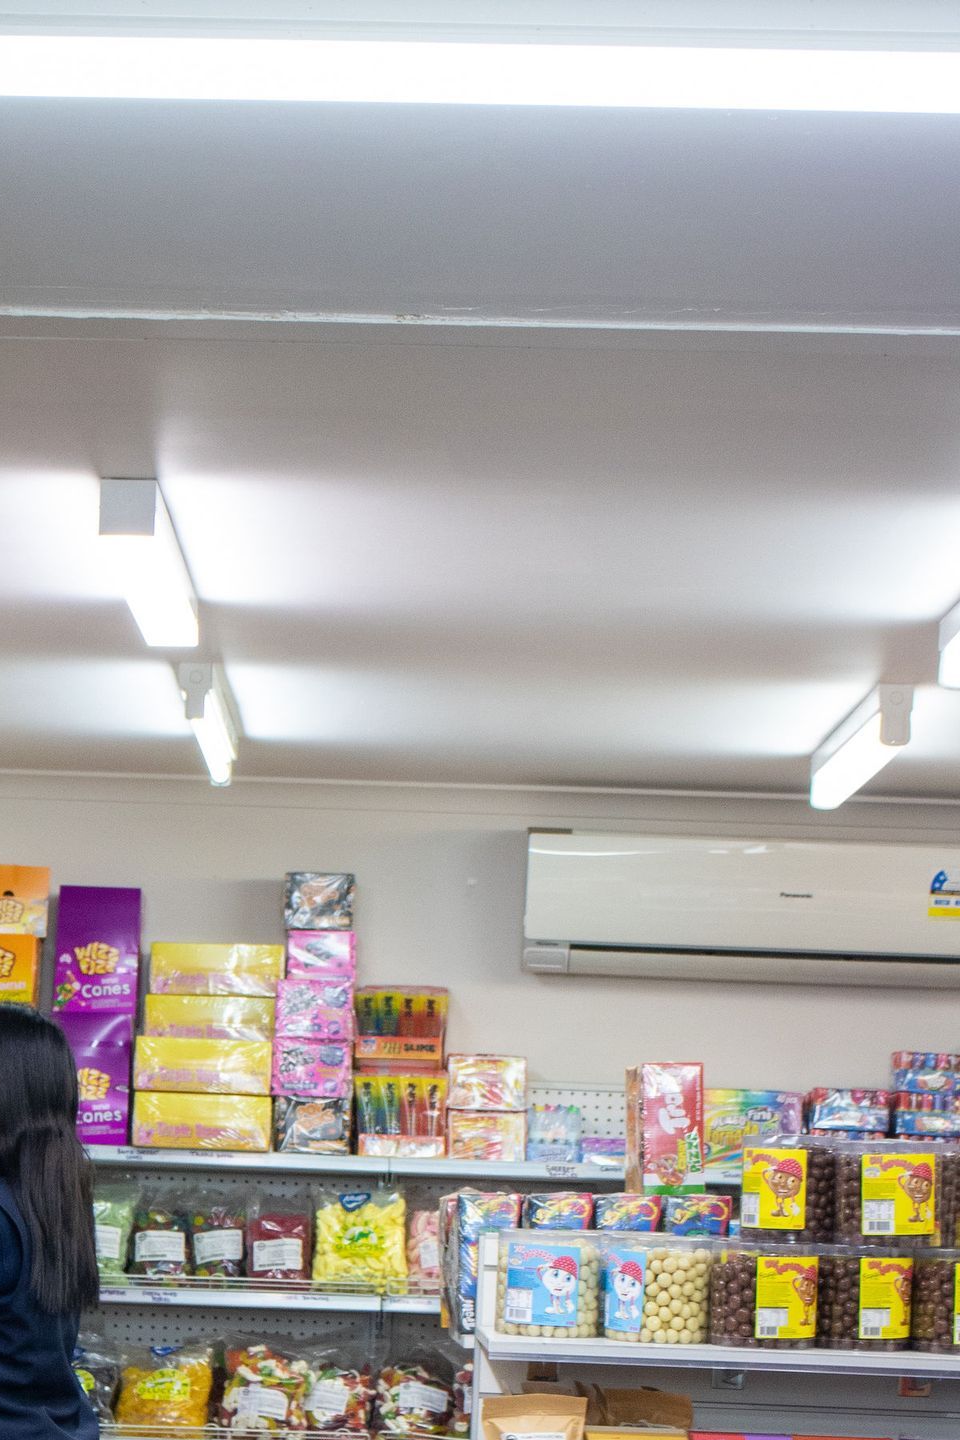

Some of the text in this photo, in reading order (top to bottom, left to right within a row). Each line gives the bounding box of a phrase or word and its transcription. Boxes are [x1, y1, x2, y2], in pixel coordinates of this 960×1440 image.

[81, 982, 131, 998] Cones
[77, 1067, 111, 1086] IZZ
[78, 1084, 109, 1100] IZZ
